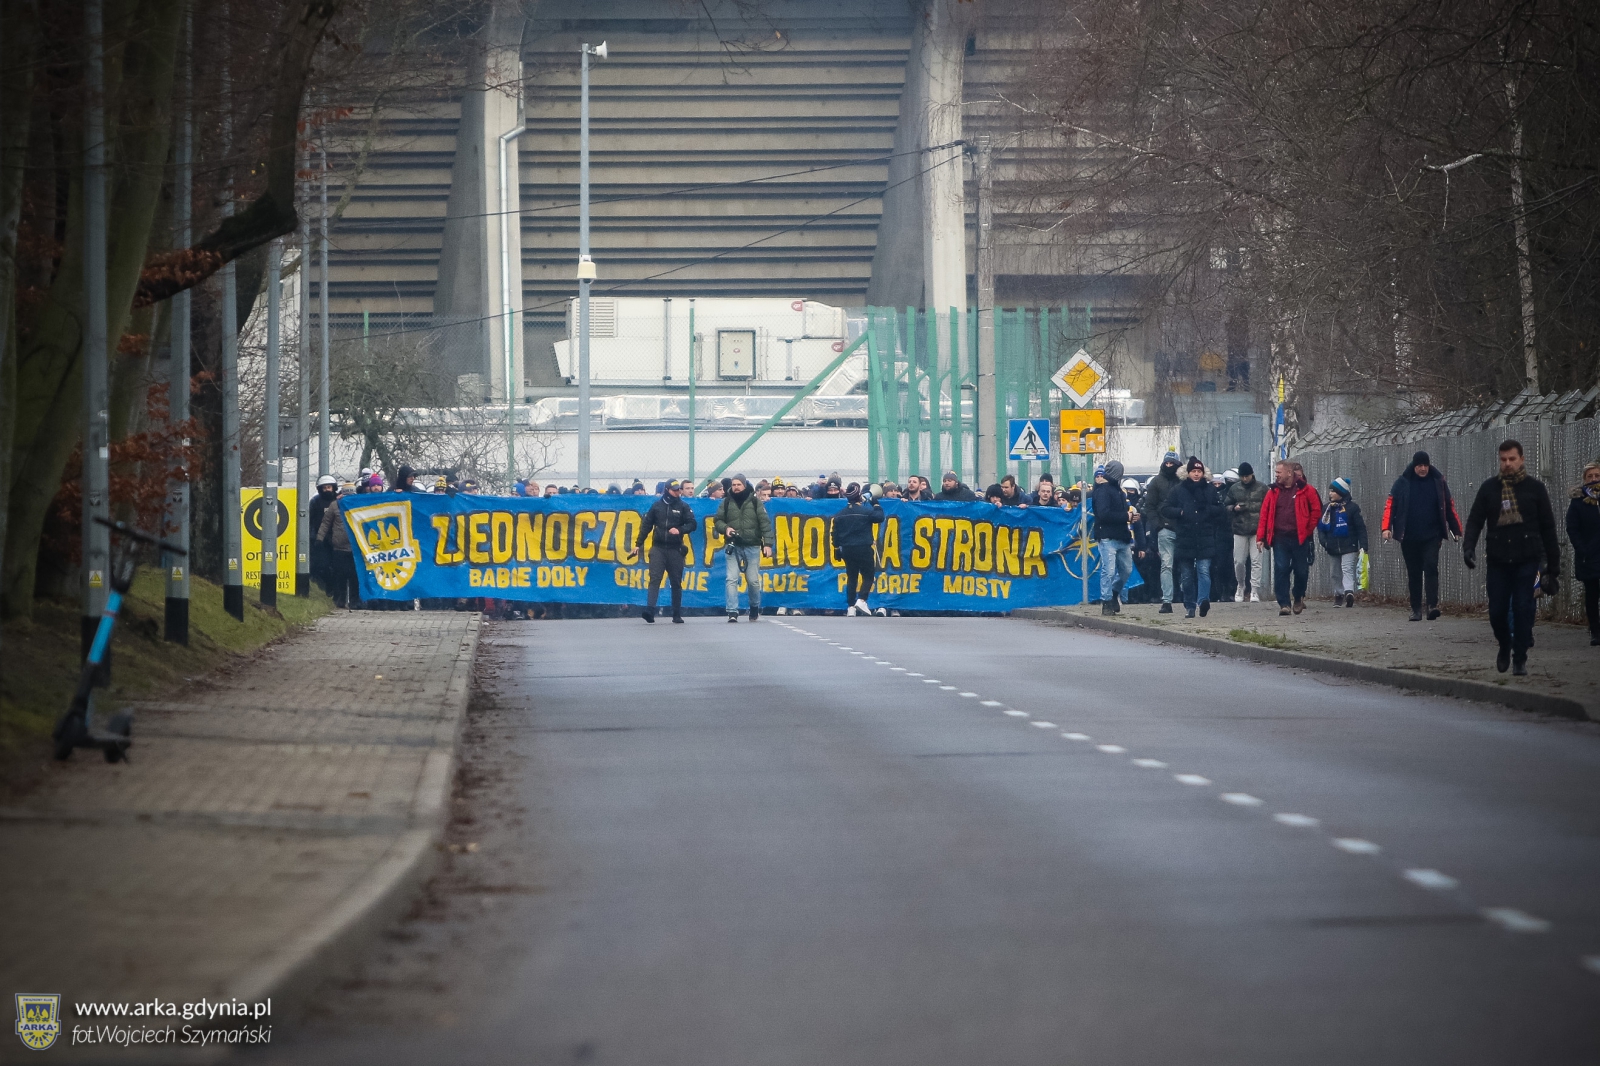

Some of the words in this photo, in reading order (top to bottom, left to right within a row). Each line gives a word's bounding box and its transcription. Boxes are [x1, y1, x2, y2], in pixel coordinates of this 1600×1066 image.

[431, 510, 696, 567] ZJEDNOCZO
[911, 516, 1047, 576] STRONA
[469, 566, 532, 588] BABIE
[537, 566, 589, 588] DOŁY
[943, 575, 1012, 599] MOSTY
